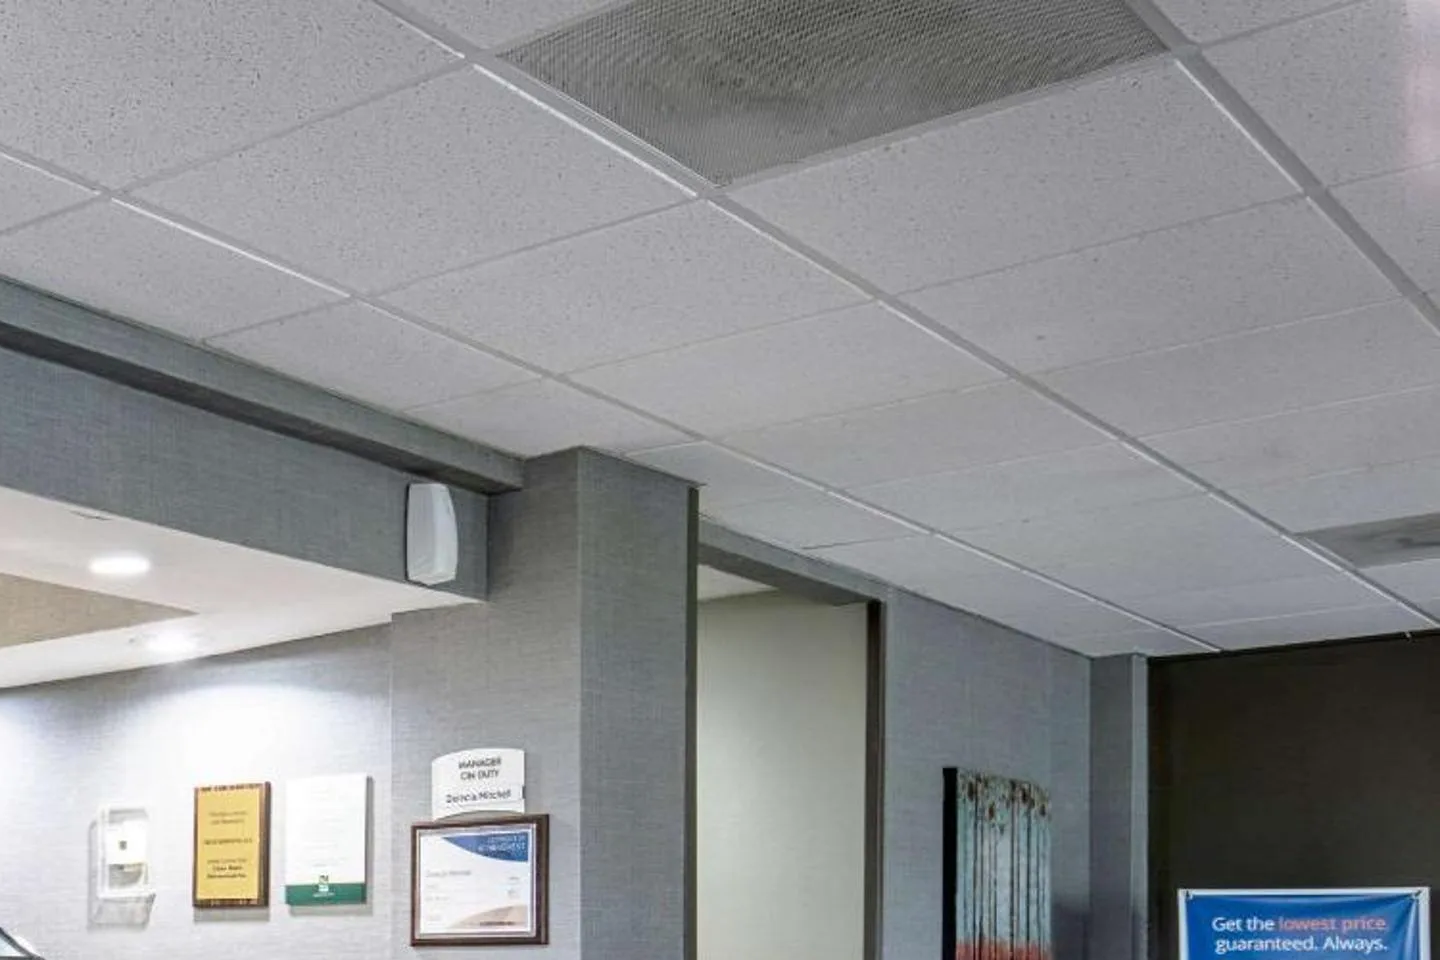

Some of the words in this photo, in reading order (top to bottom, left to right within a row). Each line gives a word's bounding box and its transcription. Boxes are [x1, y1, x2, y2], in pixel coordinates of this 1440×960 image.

[460, 770, 476, 780] ON
[478, 769, 500, 779] DUTY
[1211, 916, 1243, 932] Get
[1247, 916, 1275, 932] the
[1278, 916, 1336, 931] lowest
[1214, 936, 1318, 955] guaranteed.
[1322, 936, 1388, 955] Always.
